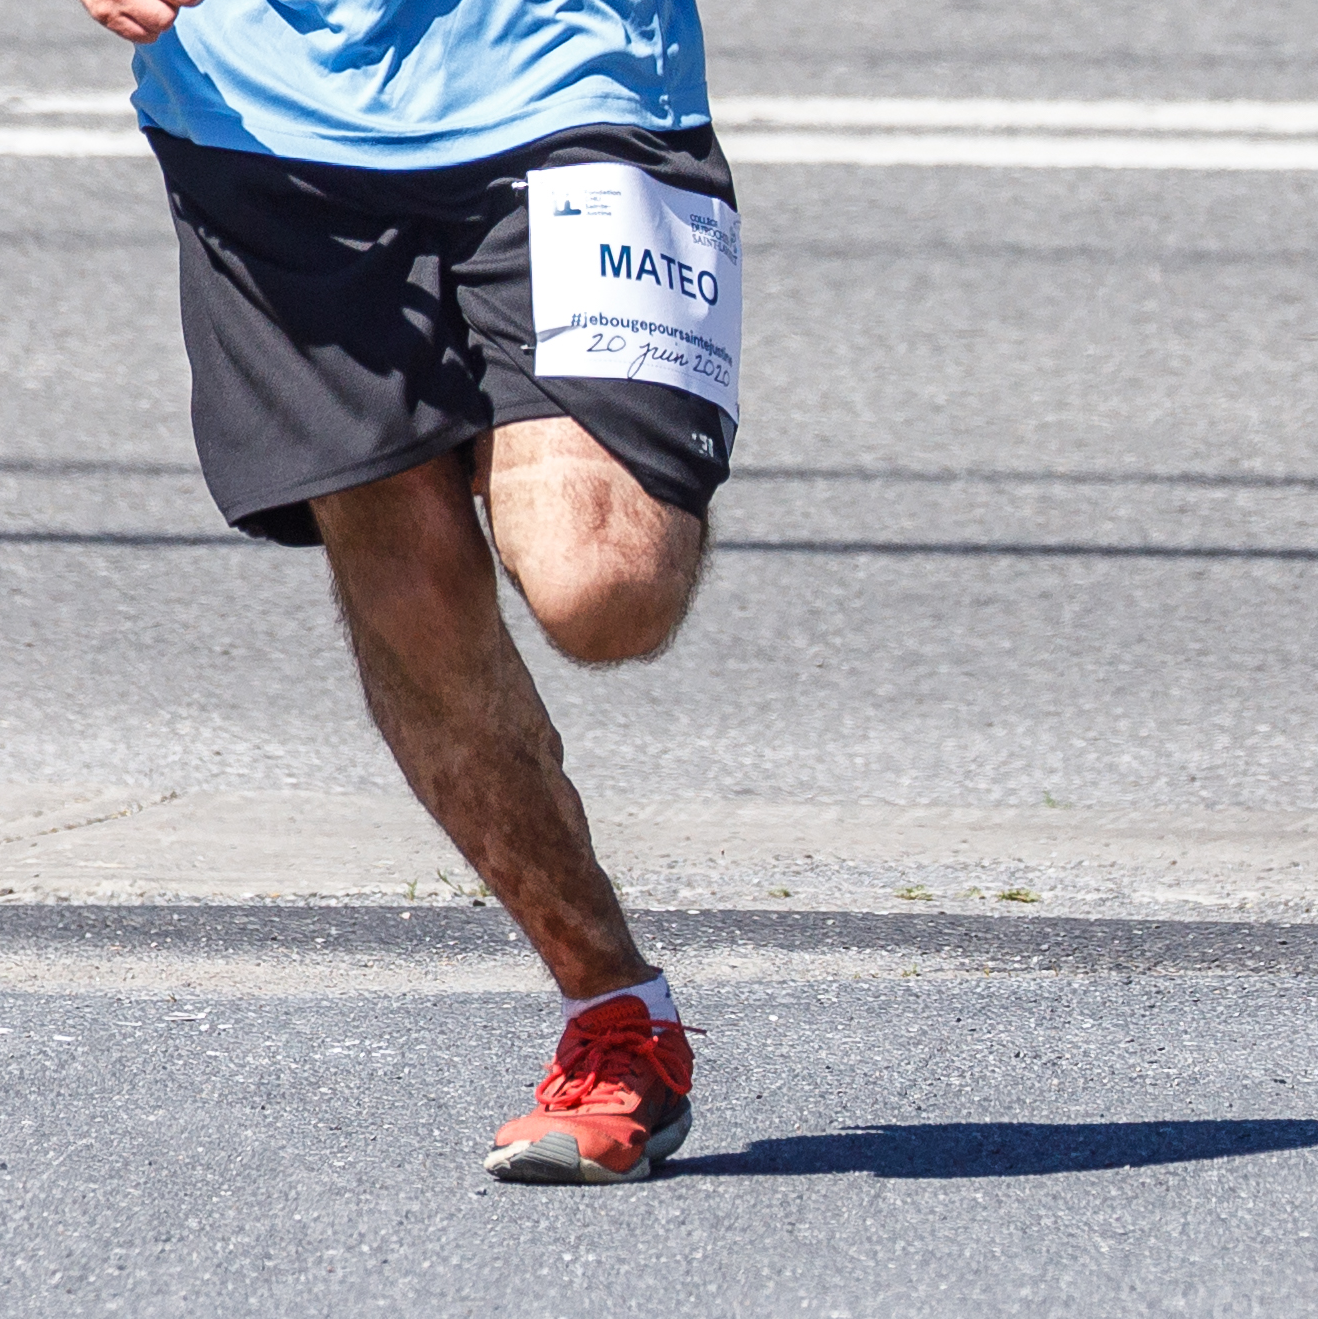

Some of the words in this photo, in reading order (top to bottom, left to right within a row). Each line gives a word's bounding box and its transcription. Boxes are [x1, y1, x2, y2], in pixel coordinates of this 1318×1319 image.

[599, 243, 719, 306] MATEO
[570, 312, 732, 367] #jebougepoursaintejustine
[587, 333, 627, 353] 20
[627, 342, 688, 380] juin
[692, 354, 730, 387] 2020
